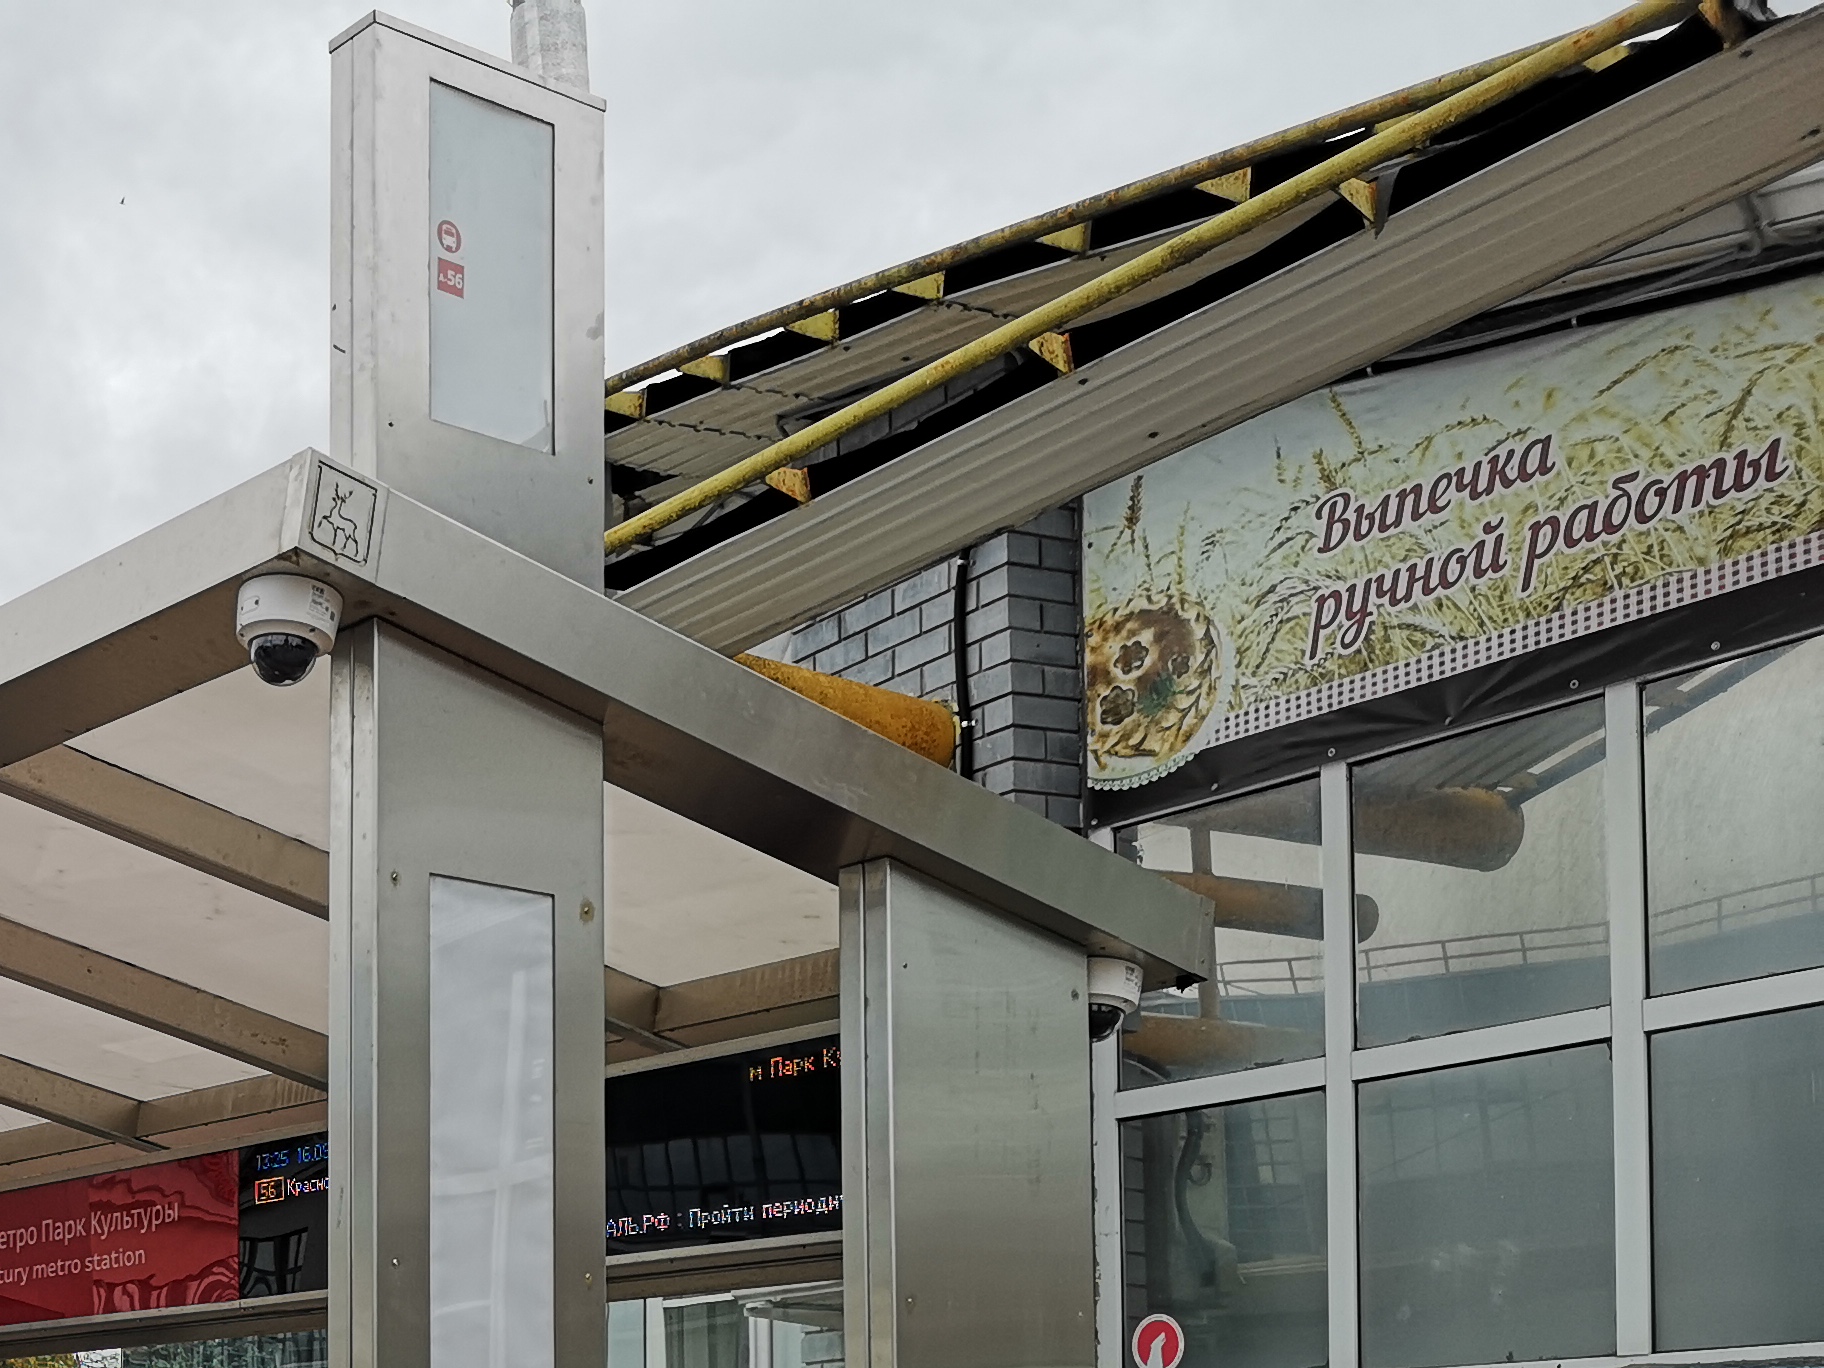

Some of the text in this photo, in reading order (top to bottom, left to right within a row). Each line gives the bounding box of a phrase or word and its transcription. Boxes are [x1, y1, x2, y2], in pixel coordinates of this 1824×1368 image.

[1315, 433, 1555, 555] Выпечка
[1307, 436, 1789, 660] ручной работы
[770, 1056, 814, 1079] Парк
[260, 1182, 276, 1200] 56
[41, 1217, 87, 1245] Парк
[90, 1202, 179, 1239] Культуры
[689, 1204, 754, 1229] Пройти
[32, 1259, 81, 1281] metro
[84, 1247, 146, 1272] station
